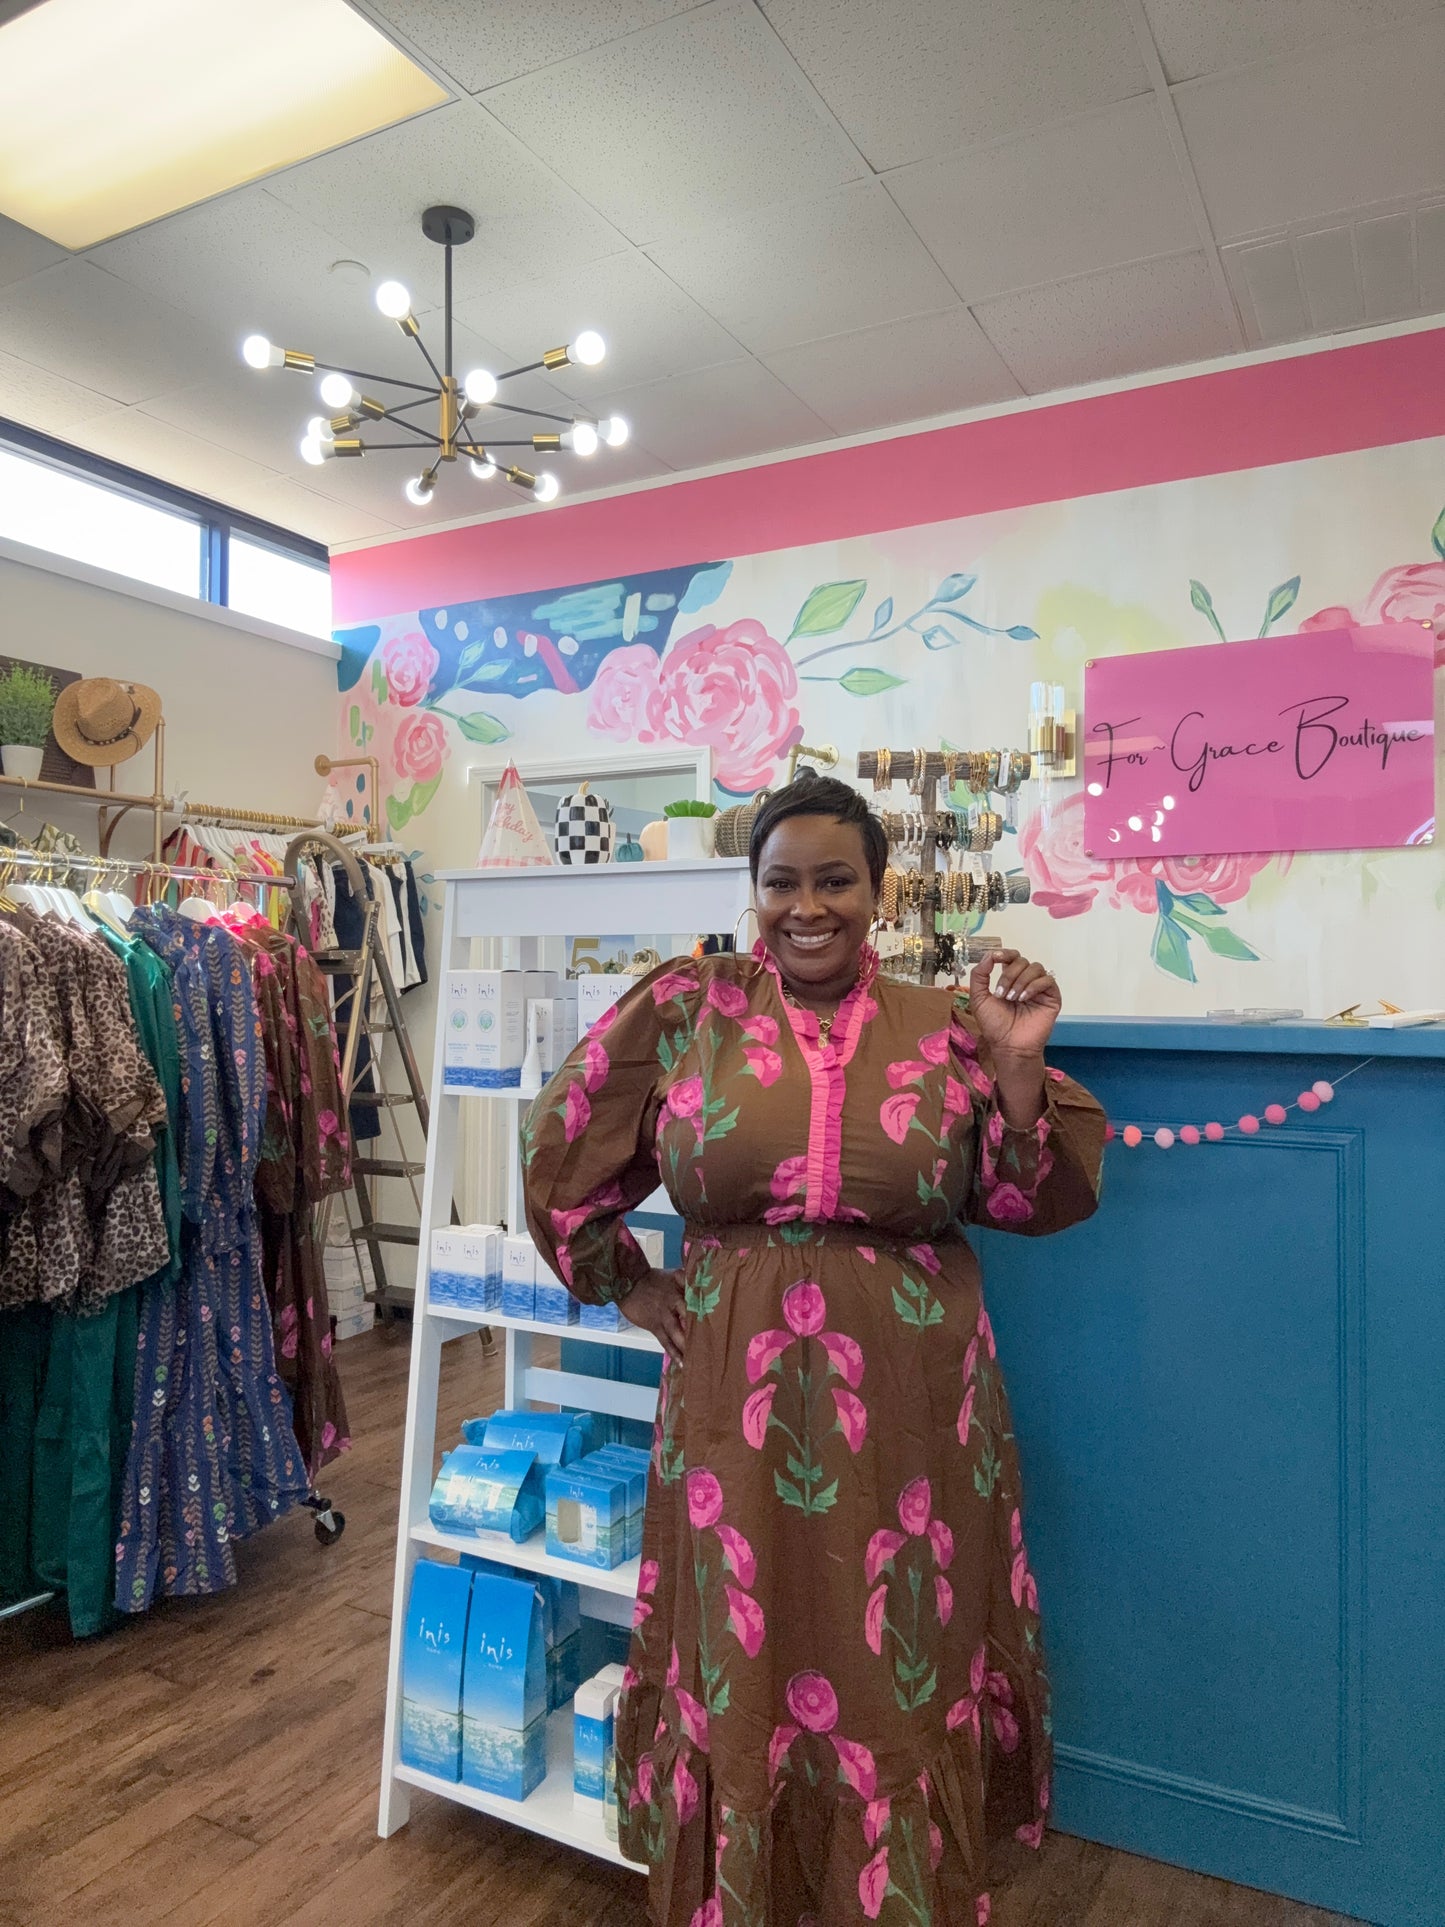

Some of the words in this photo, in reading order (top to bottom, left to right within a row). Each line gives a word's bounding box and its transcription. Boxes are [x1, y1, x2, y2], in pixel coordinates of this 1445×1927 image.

[1093, 716, 1149, 789] For
[1171, 711, 1286, 793] Grace
[1278, 696, 1425, 781] Boutique
[451, 983, 468, 997] inis
[478, 983, 495, 998] inis
[582, 985, 600, 998] inis
[436, 1240, 452, 1254] inis
[464, 1244, 480, 1258] inis
[510, 1250, 527, 1264] inis
[511, 1433, 535, 1450] inis
[475, 1456, 500, 1470] inis
[419, 1617, 451, 1648] inis
[481, 1632, 513, 1664] inis
[578, 1726, 599, 1743] inis
